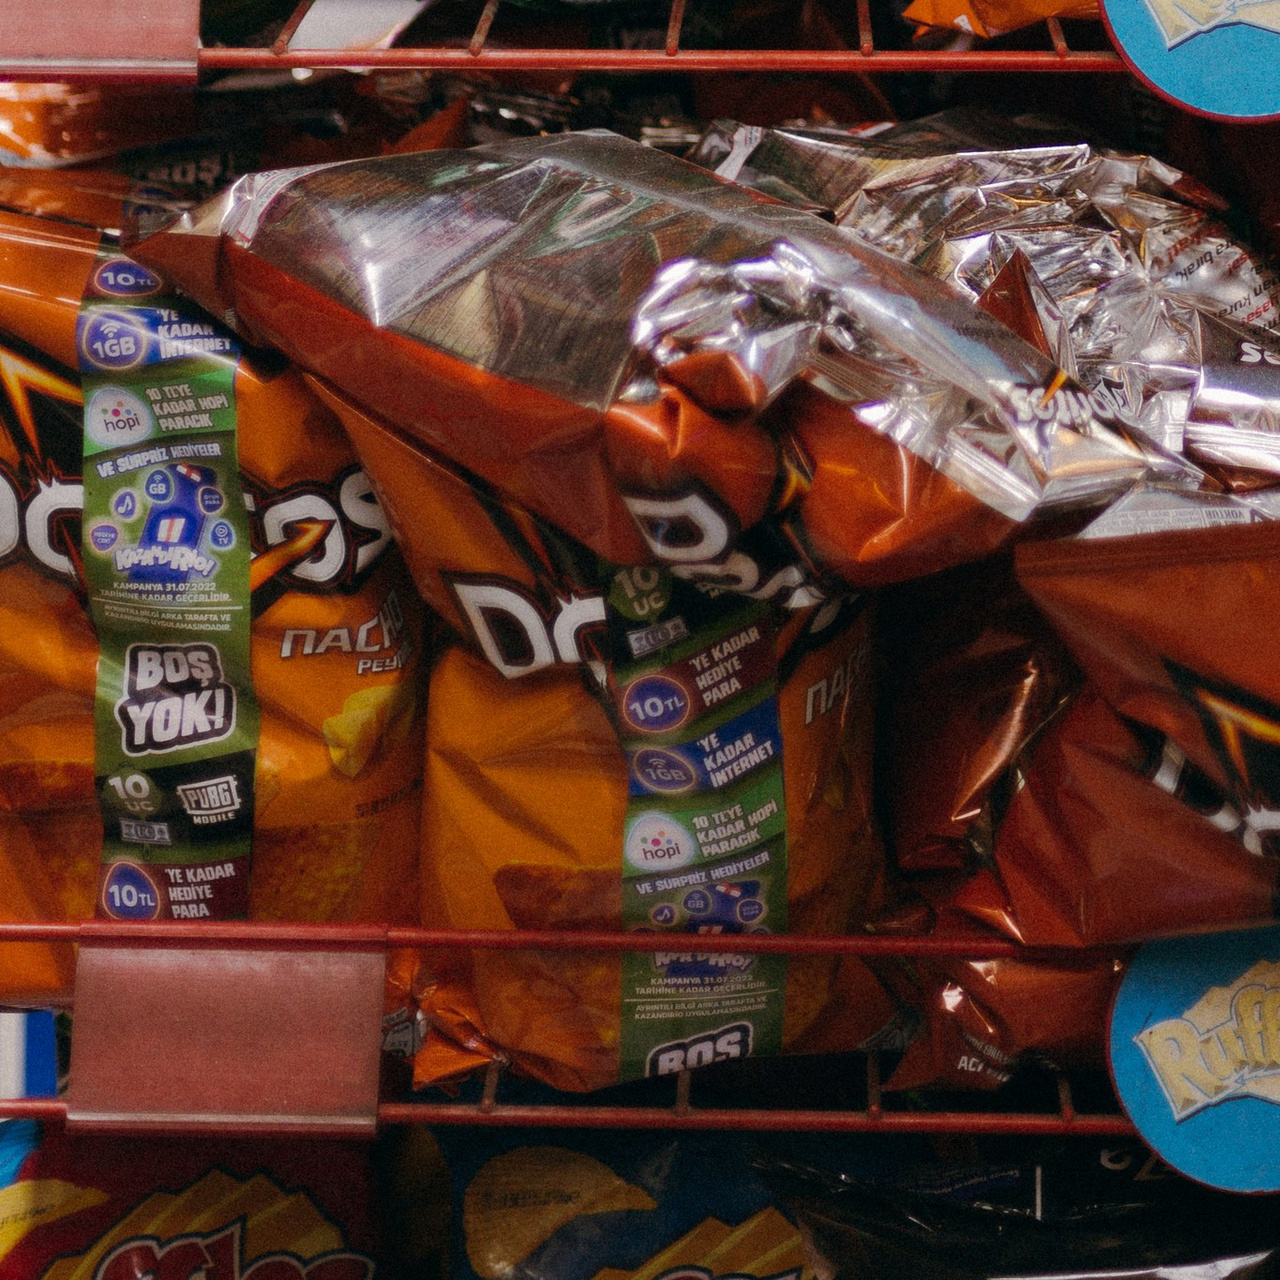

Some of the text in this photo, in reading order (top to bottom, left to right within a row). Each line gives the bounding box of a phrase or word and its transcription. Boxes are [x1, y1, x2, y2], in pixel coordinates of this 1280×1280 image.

[157, 322, 215, 339] KADAR
[92, 336, 136, 359] 1GB
[150, 392, 229, 416] KADAR HOPİ
[103, 412, 141, 433] hopi
[158, 412, 214, 432] PARACIK
[96, 442, 223, 479] VE SÜRPRİZ HEDİYELER
[148, 483, 167, 496] GB
[113, 580, 217, 592] KAMPANYA 31.07.2022
[141, 592, 233, 603] KADAR GEÇERLİDİR.
[632, 590, 666, 617] UC
[183, 613, 219, 622] TARAFTA
[710, 625, 762, 662] KADAR
[134, 649, 215, 691] BOŞ
[694, 654, 744, 691] HEDİYE
[701, 676, 743, 708] PARA
[126, 687, 226, 746] YOK!
[702, 732, 757, 772] KADAR
[644, 767, 687, 782] 1GB
[709, 740, 775, 789] İNTERNET
[107, 773, 151, 800] 10
[187, 781, 231, 810] PUBG
[192, 811, 237, 825] MOBILE
[691, 815, 710, 830] 10
[695, 797, 780, 844] KADAR HOPİ
[641, 842, 682, 861] hopi
[700, 827, 762, 859] PARACIK
[185, 862, 237, 881] KADAR
[635, 850, 772, 896] VE SÜRPRİZ HEDİYELER
[167, 881, 214, 902] HEDİYE
[170, 902, 210, 919] PARA
[650, 973, 754, 986] KAMPANYA 31.07.2022
[678, 985, 712, 995] KADAR
